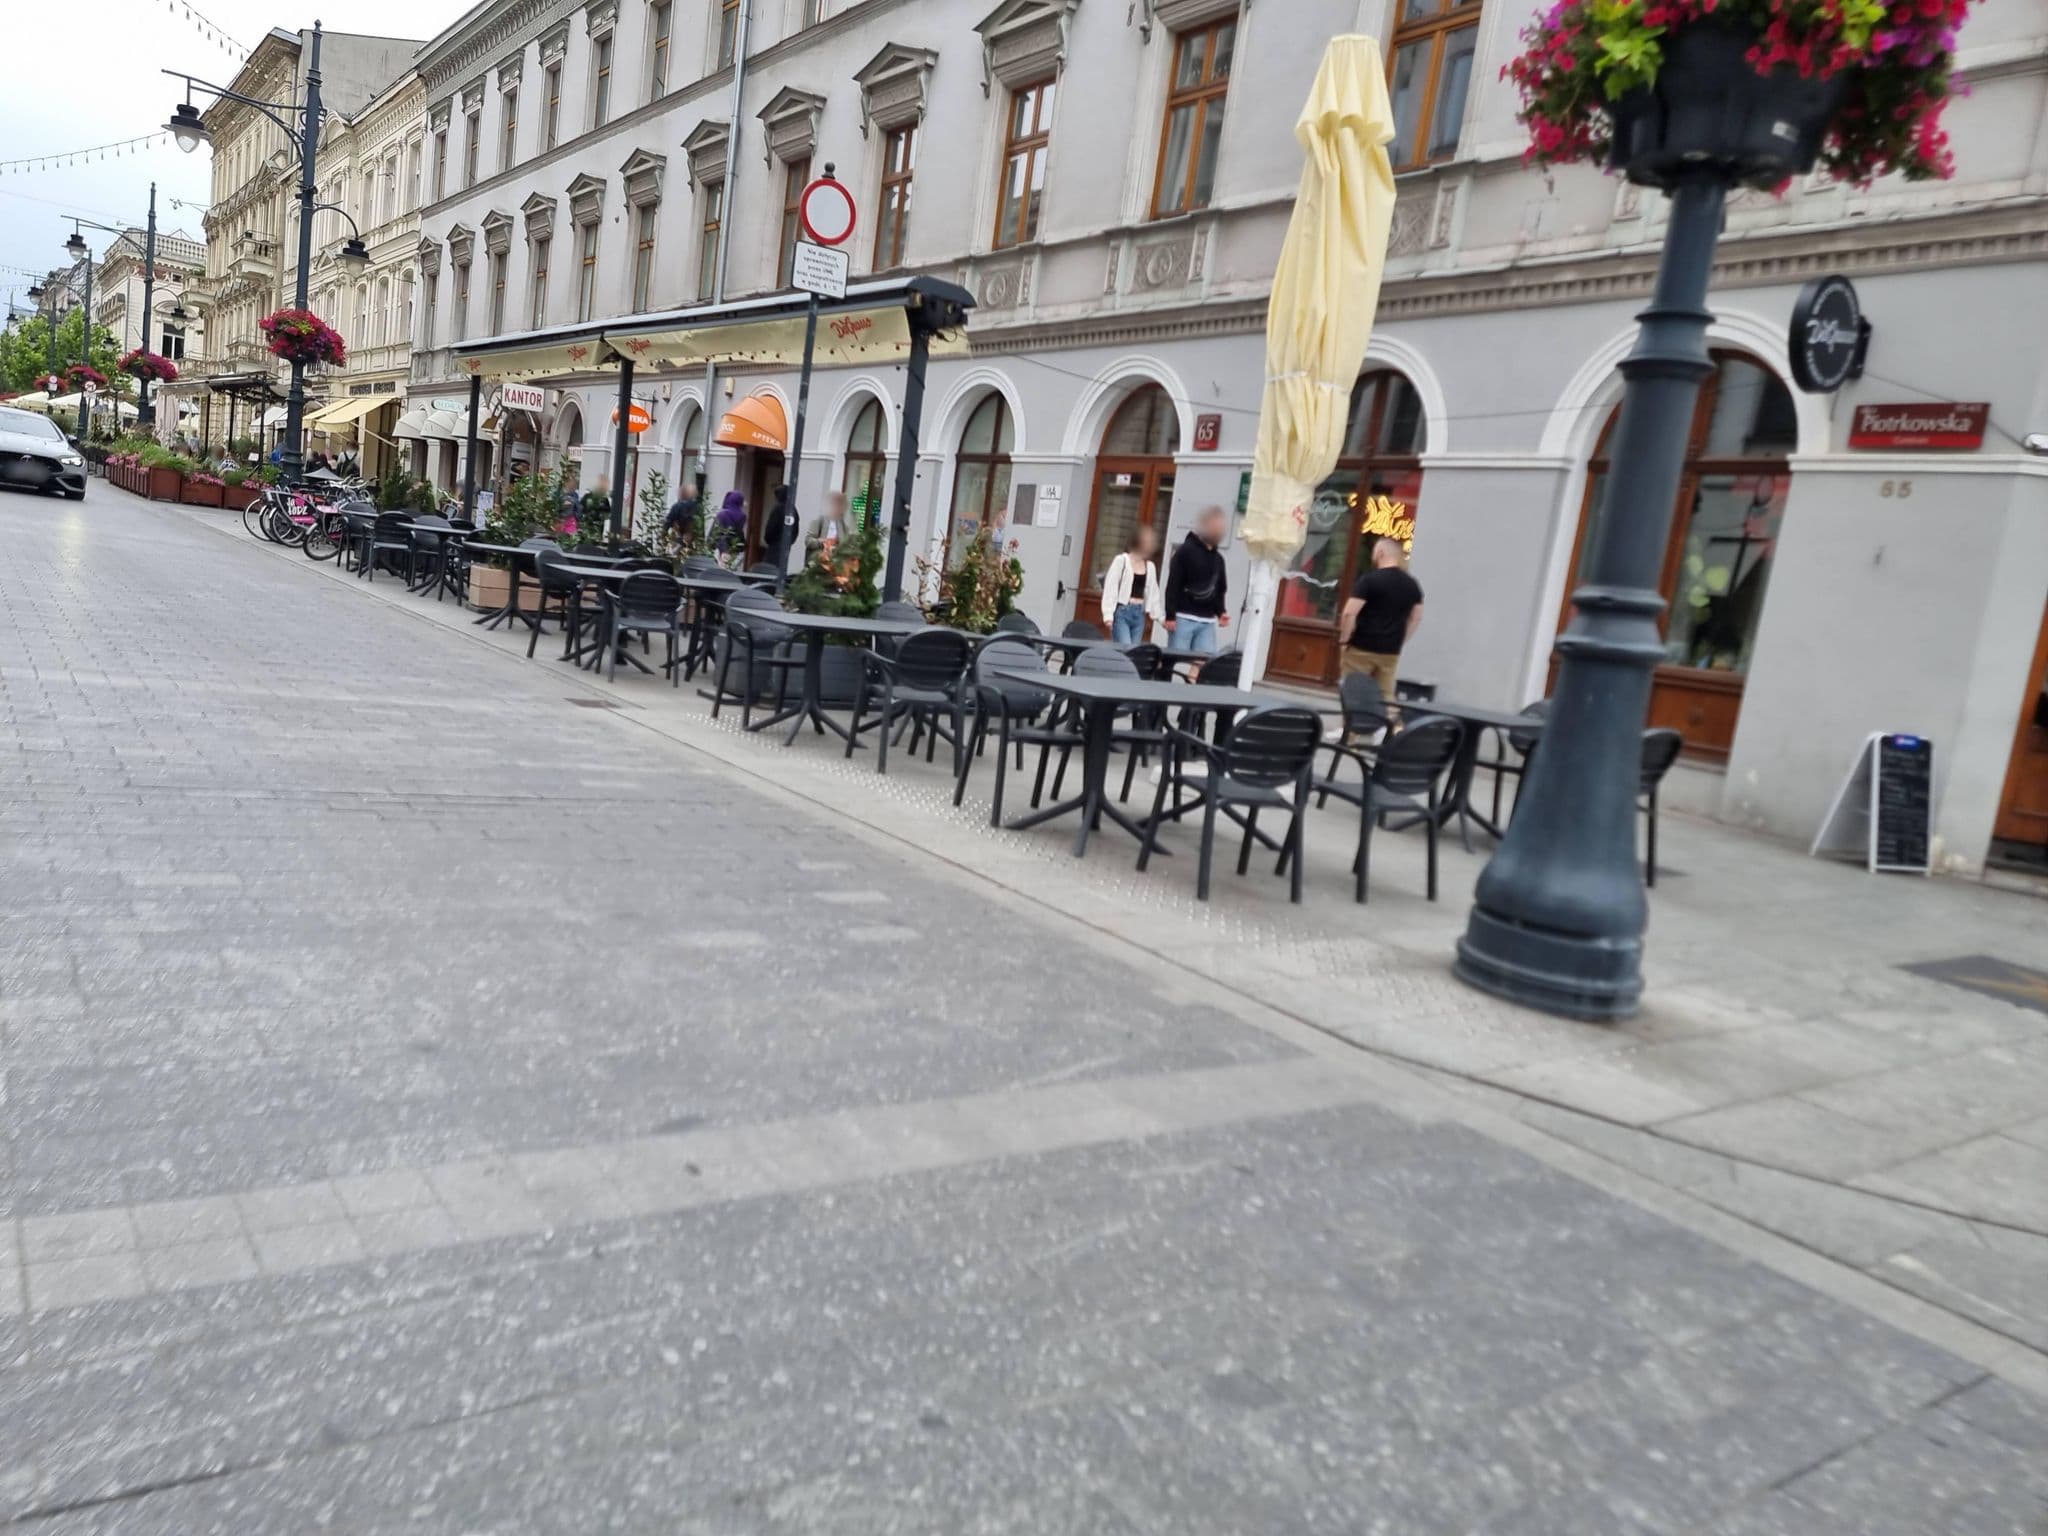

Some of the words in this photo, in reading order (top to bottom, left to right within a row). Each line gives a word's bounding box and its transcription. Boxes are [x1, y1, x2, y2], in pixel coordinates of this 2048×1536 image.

[504, 388, 542, 408] KANTOR
[629, 415, 649, 425] TEKA
[1860, 412, 1972, 433] Piotrkowska
[751, 431, 781, 447] APTEKA
[1198, 422, 1216, 441] 65
